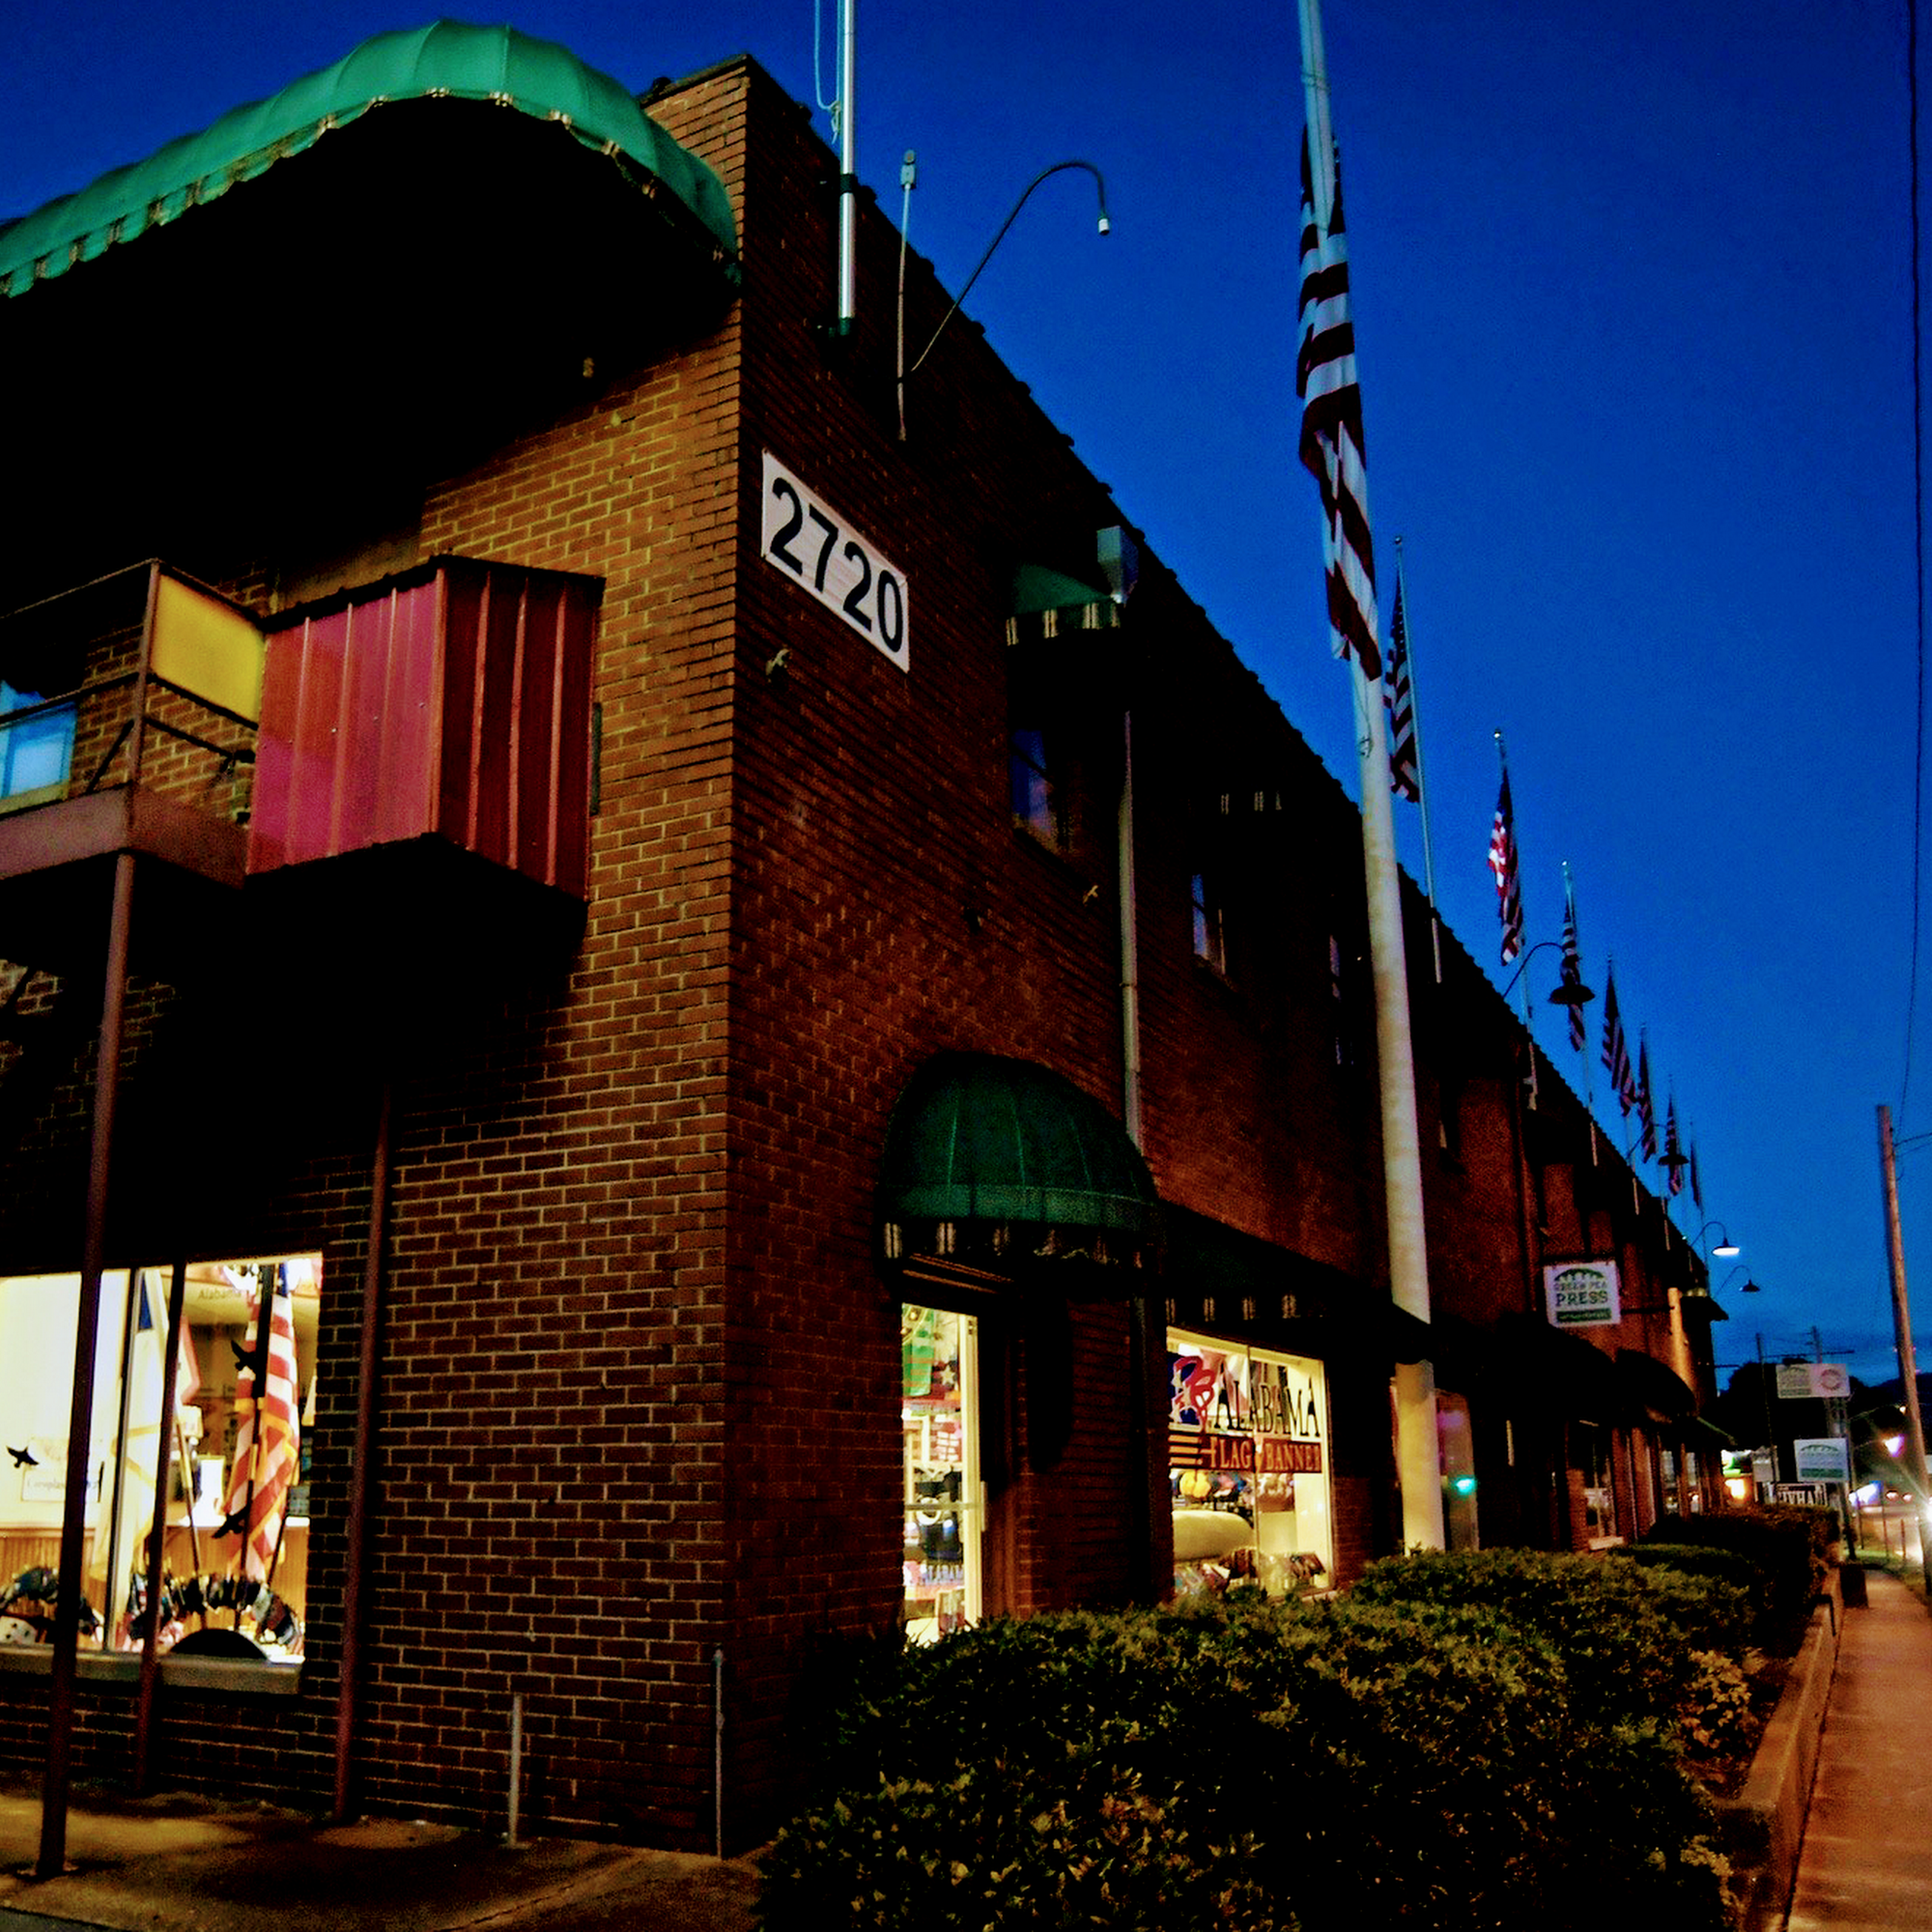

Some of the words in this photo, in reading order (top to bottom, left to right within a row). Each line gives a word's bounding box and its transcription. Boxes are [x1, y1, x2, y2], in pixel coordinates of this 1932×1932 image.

[770, 477, 902, 653] 2720
[1556, 1291, 1607, 1306] PRESS
[1214, 1361, 1321, 1436] ALABAMA
[1202, 1435, 1252, 1469] FLAG
